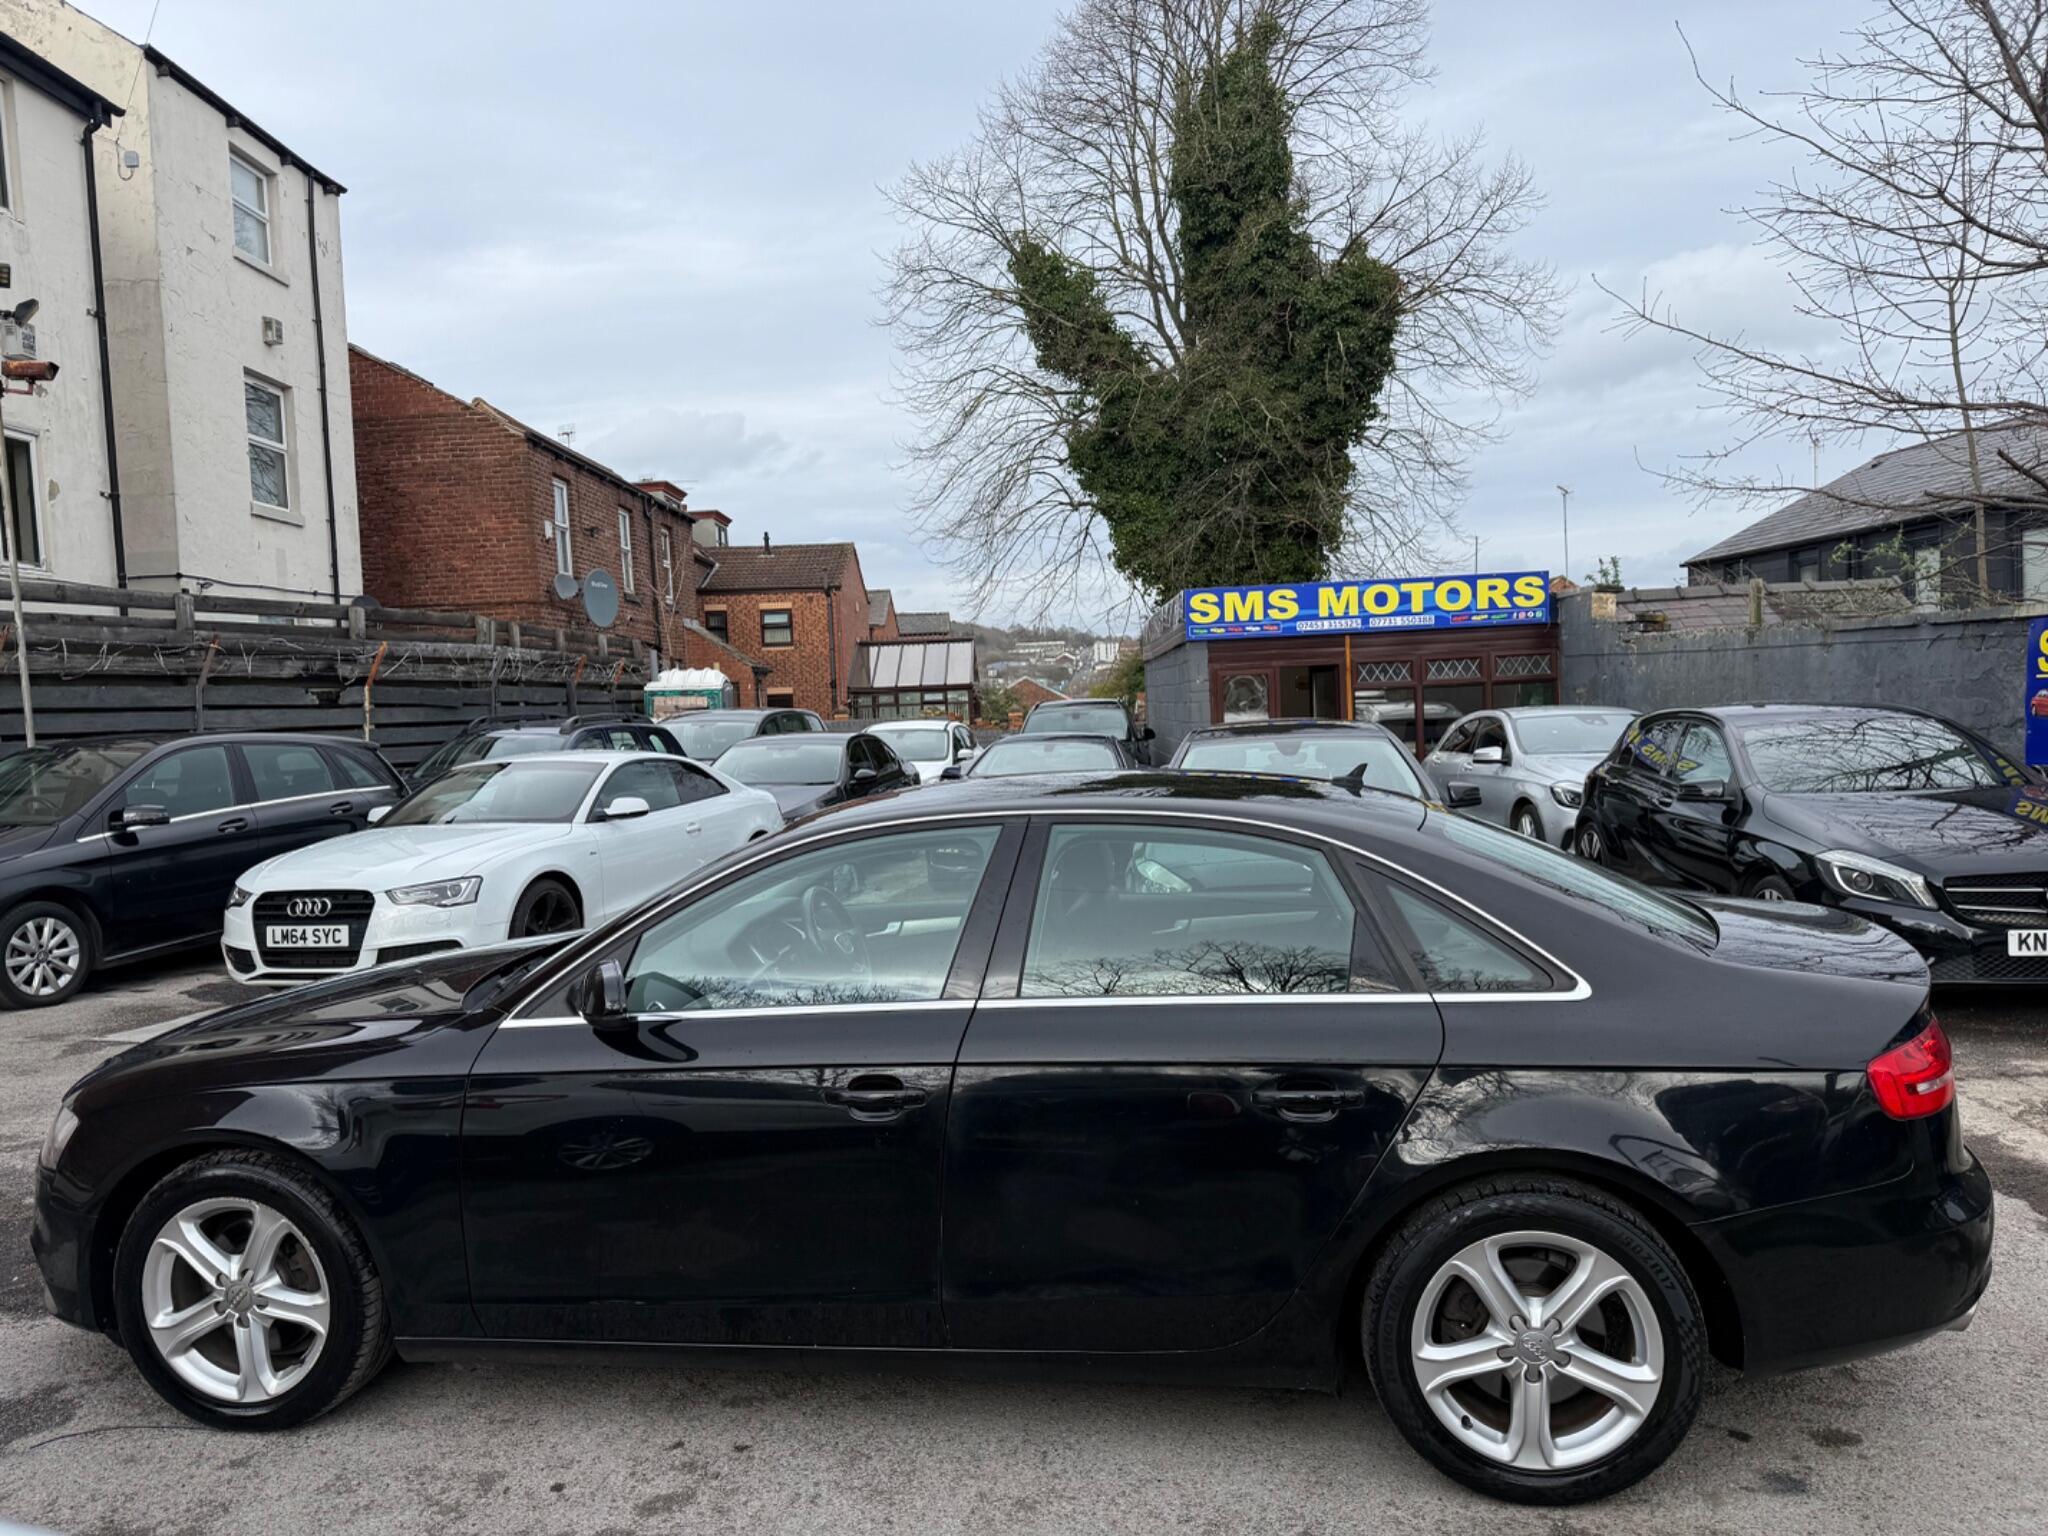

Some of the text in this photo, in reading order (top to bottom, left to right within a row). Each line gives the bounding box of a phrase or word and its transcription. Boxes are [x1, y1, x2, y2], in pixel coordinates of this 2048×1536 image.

[1189, 575, 1546, 624] SMS MOTORS
[272, 928, 342, 945] LM64 SYC
[2017, 932, 2048, 952] KN
